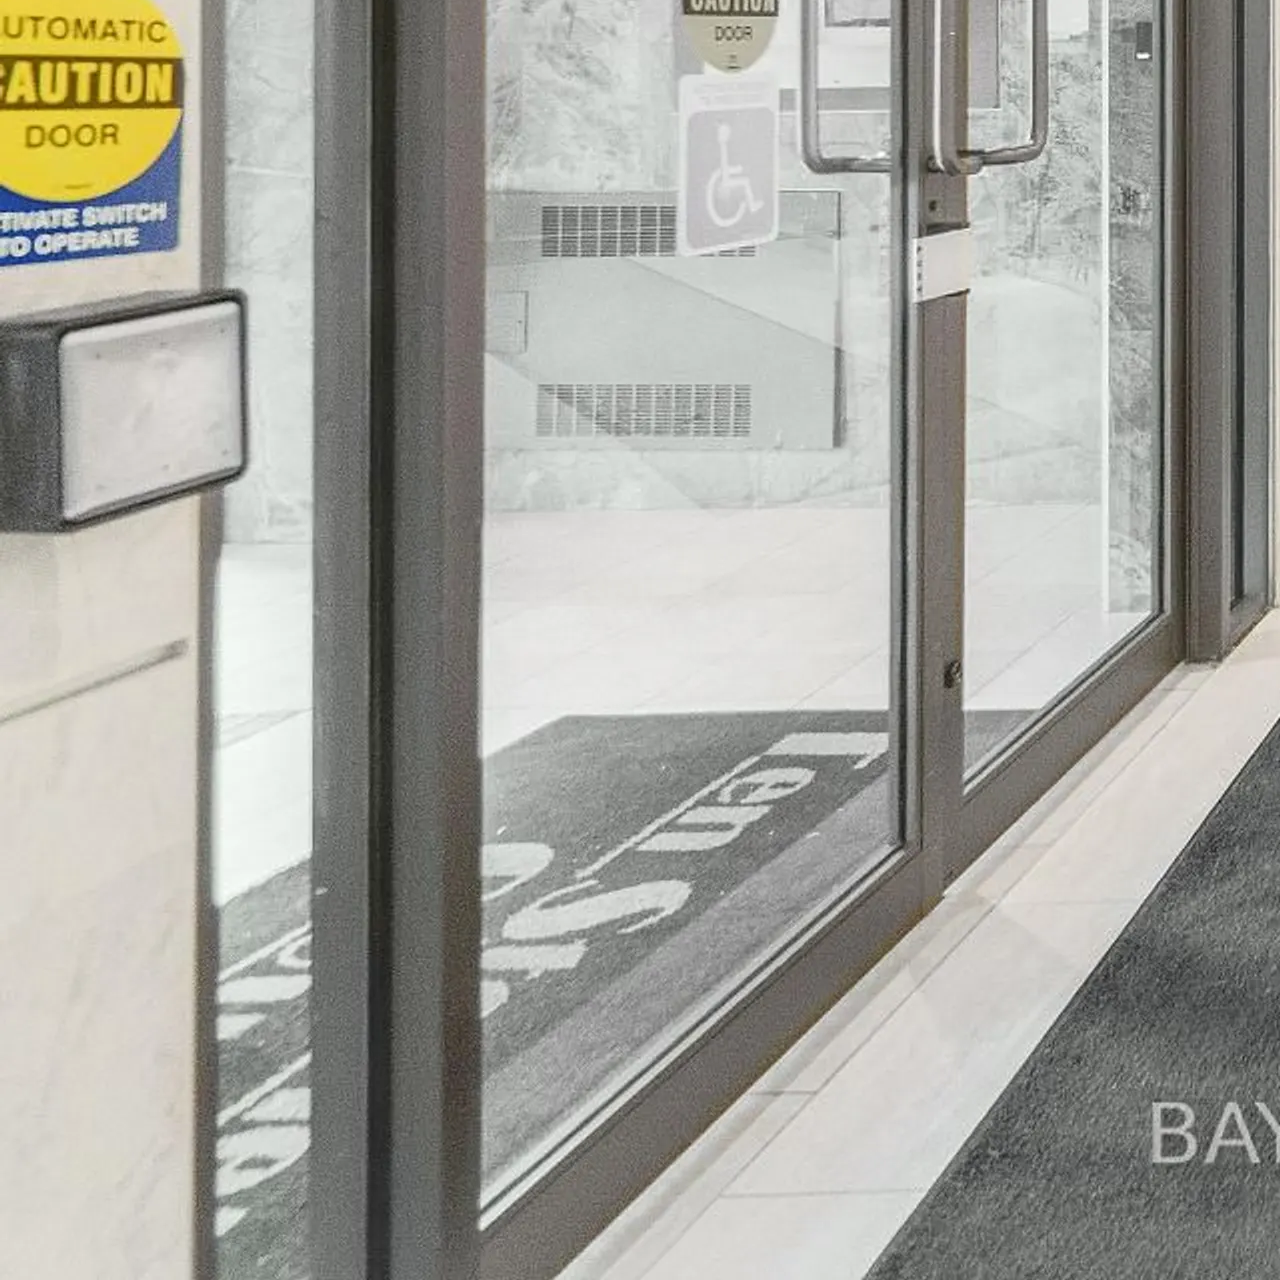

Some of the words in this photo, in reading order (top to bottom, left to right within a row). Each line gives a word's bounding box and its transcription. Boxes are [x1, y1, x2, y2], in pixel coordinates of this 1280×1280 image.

[1, 16, 168, 43] UTOMATIC
[715, 26, 753, 41] DOOR
[0, 60, 174, 104] AUTION
[25, 123, 120, 148] DOOR
[0, 208, 80, 232] TIVATE
[82, 202, 168, 227] SWITCH
[34, 227, 140, 254] OPERATE
